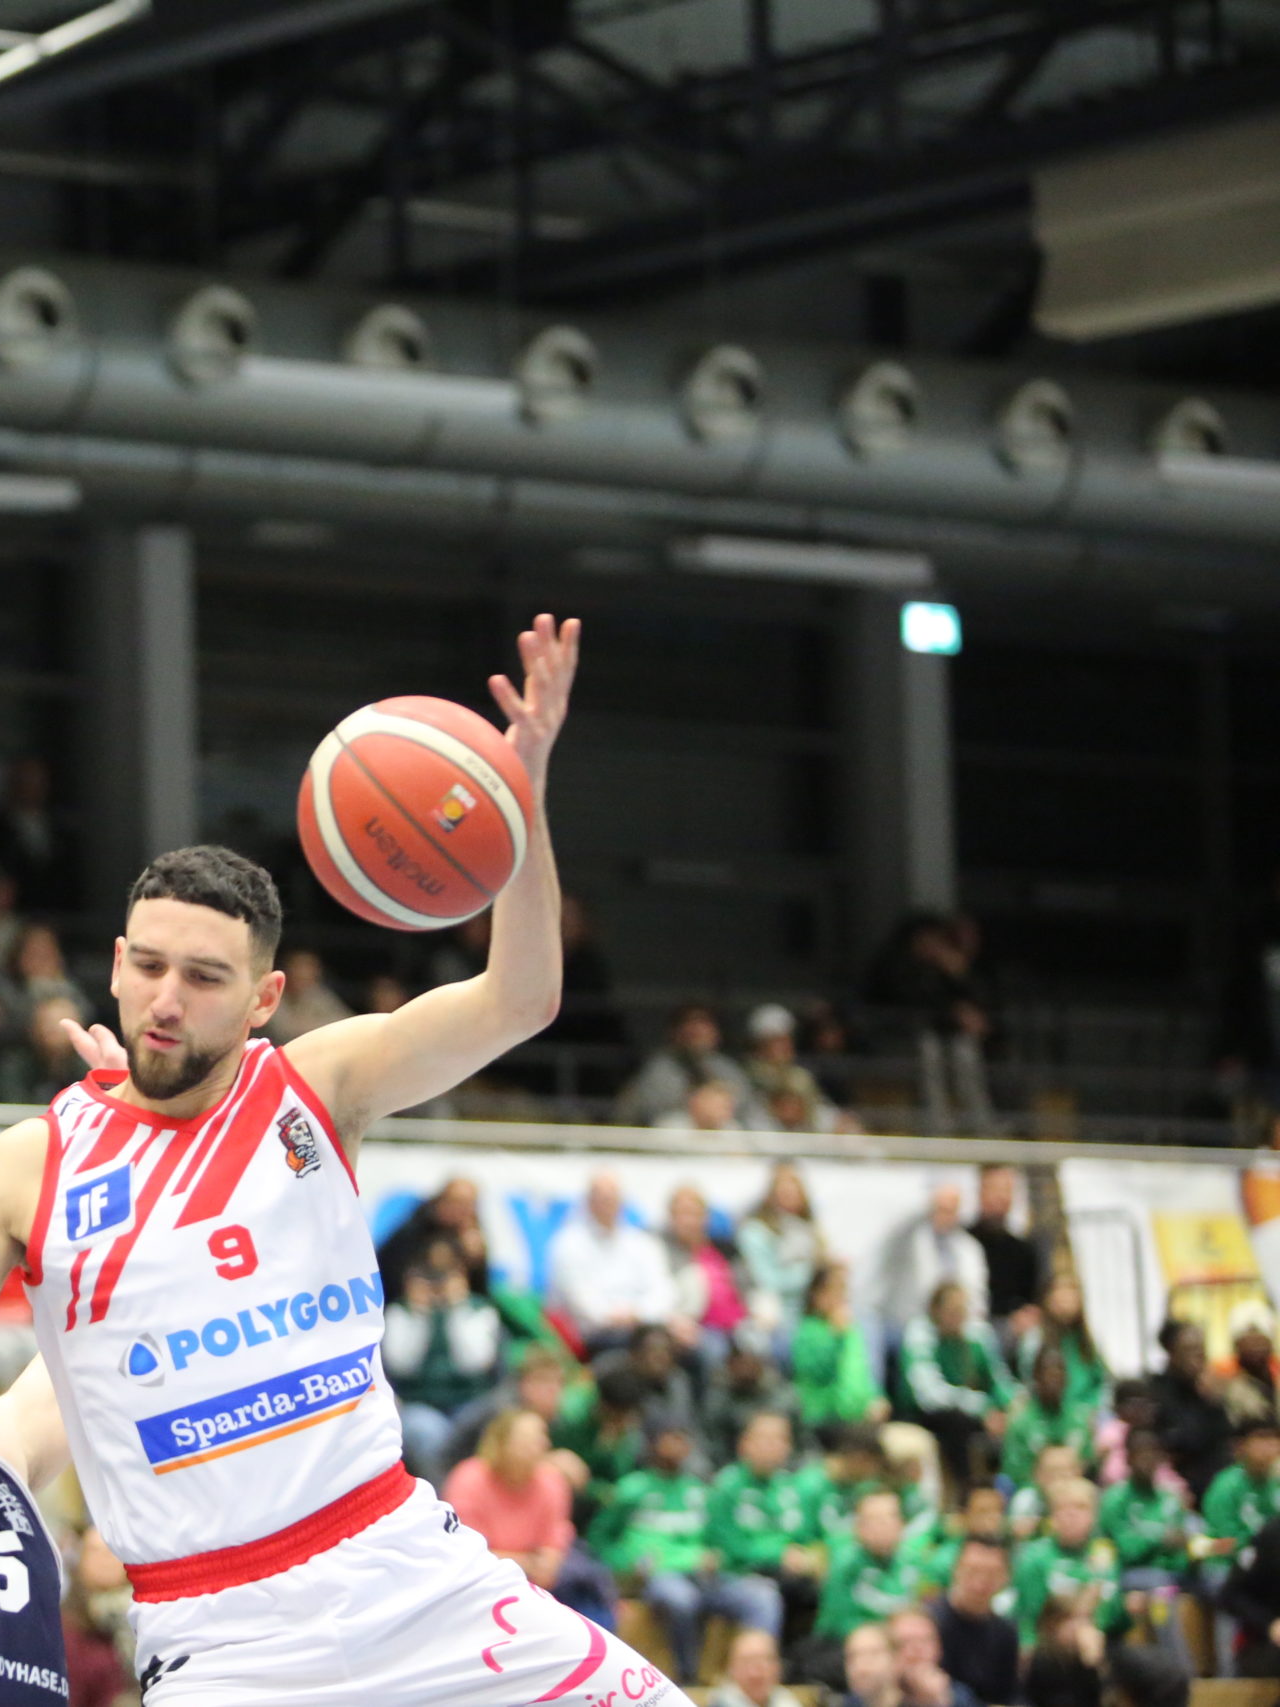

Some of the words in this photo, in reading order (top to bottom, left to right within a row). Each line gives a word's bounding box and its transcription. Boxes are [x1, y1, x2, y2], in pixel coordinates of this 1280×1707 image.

[364, 818, 445, 895] molten
[75, 1182, 109, 1238] JF
[208, 1224, 259, 1280] 9
[166, 1272, 384, 1370] POLYGON
